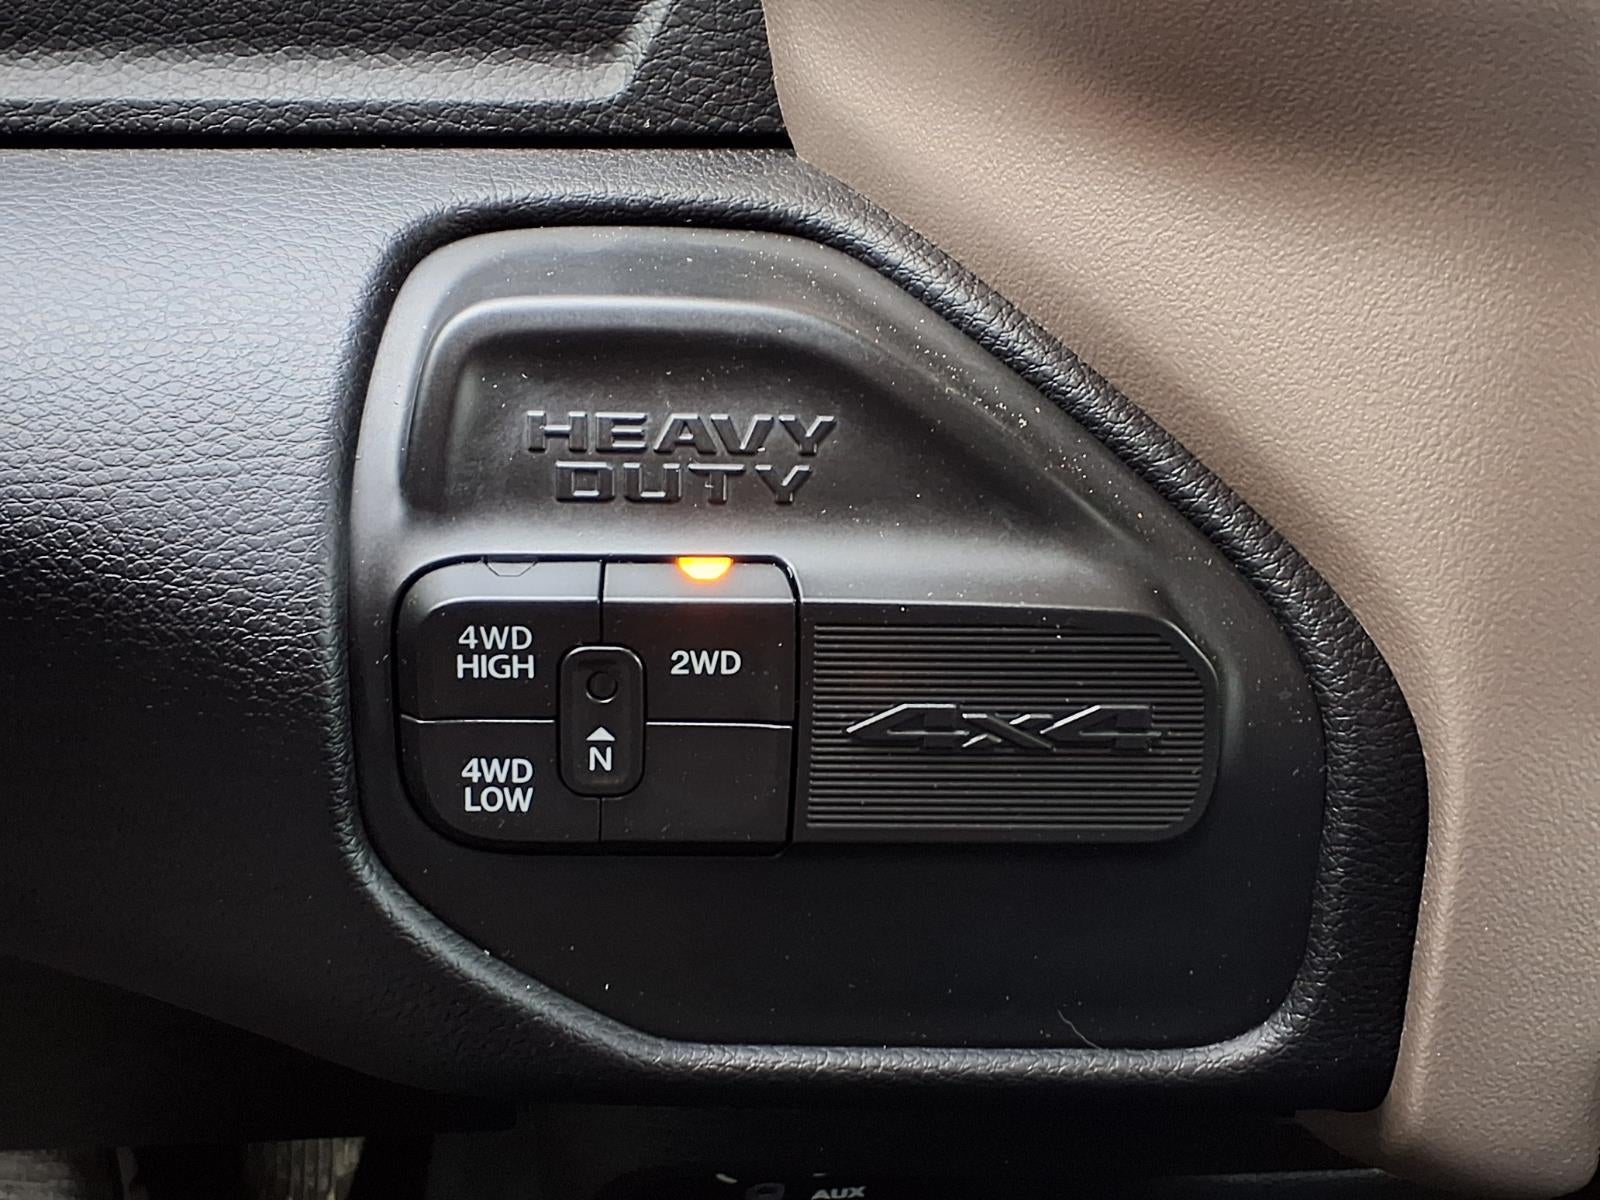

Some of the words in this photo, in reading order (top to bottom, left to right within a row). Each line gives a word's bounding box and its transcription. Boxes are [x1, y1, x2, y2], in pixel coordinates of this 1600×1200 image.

[526, 410, 838, 455] HEAVY
[555, 461, 813, 504] DUTY
[458, 625, 533, 650] 4WD
[456, 654, 536, 679] HIGH
[670, 650, 742, 675] 2WD
[461, 758, 534, 783] 4WD
[588, 746, 613, 771] N
[464, 787, 534, 812] LOW
[811, 1186, 867, 1200] AUX
